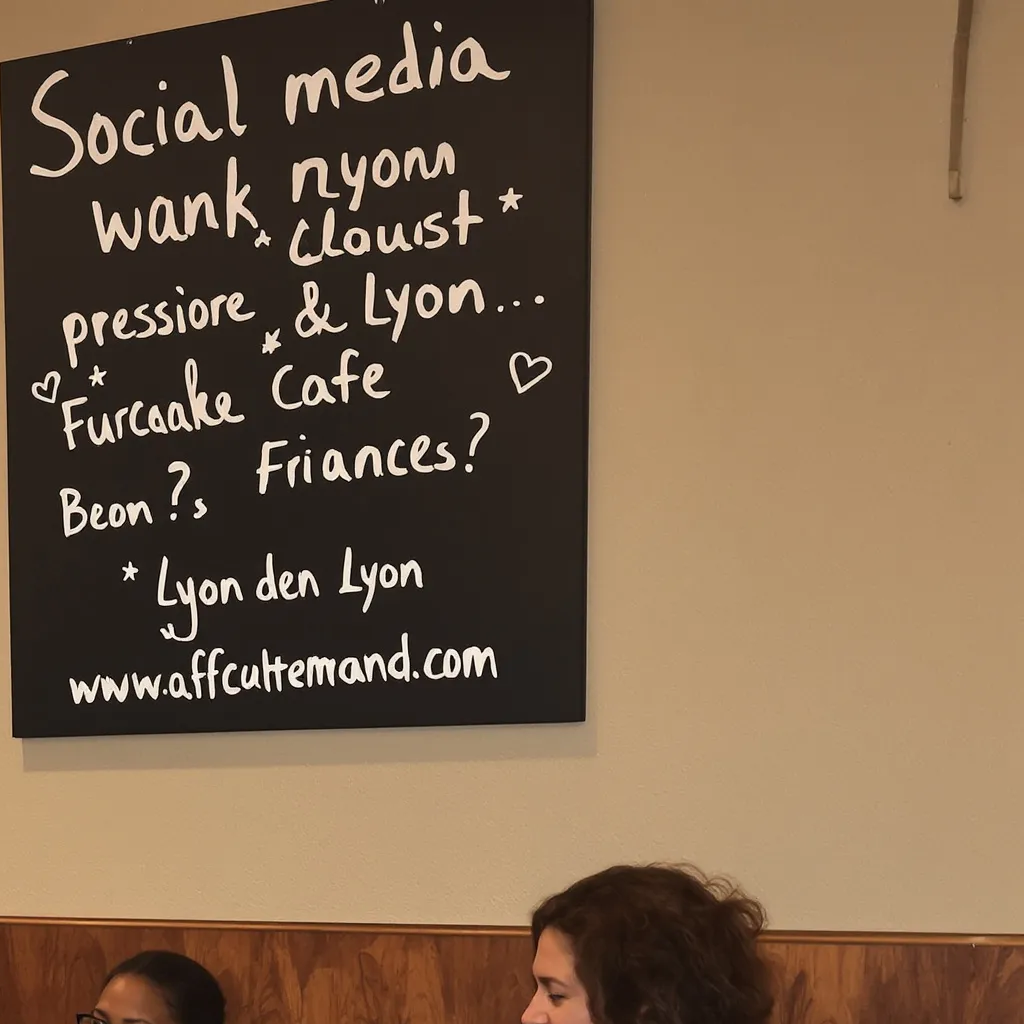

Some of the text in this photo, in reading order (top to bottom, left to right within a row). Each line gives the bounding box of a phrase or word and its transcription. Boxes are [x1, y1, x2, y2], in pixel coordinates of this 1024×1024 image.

[30, 20, 511, 178] Social media
[91, 156, 259, 254] wank
[62, 285, 256, 370] pressiore
[294, 280, 348, 338] &
[59, 487, 154, 538] Beon
[157, 546, 424, 642] Lyon den Lyon
